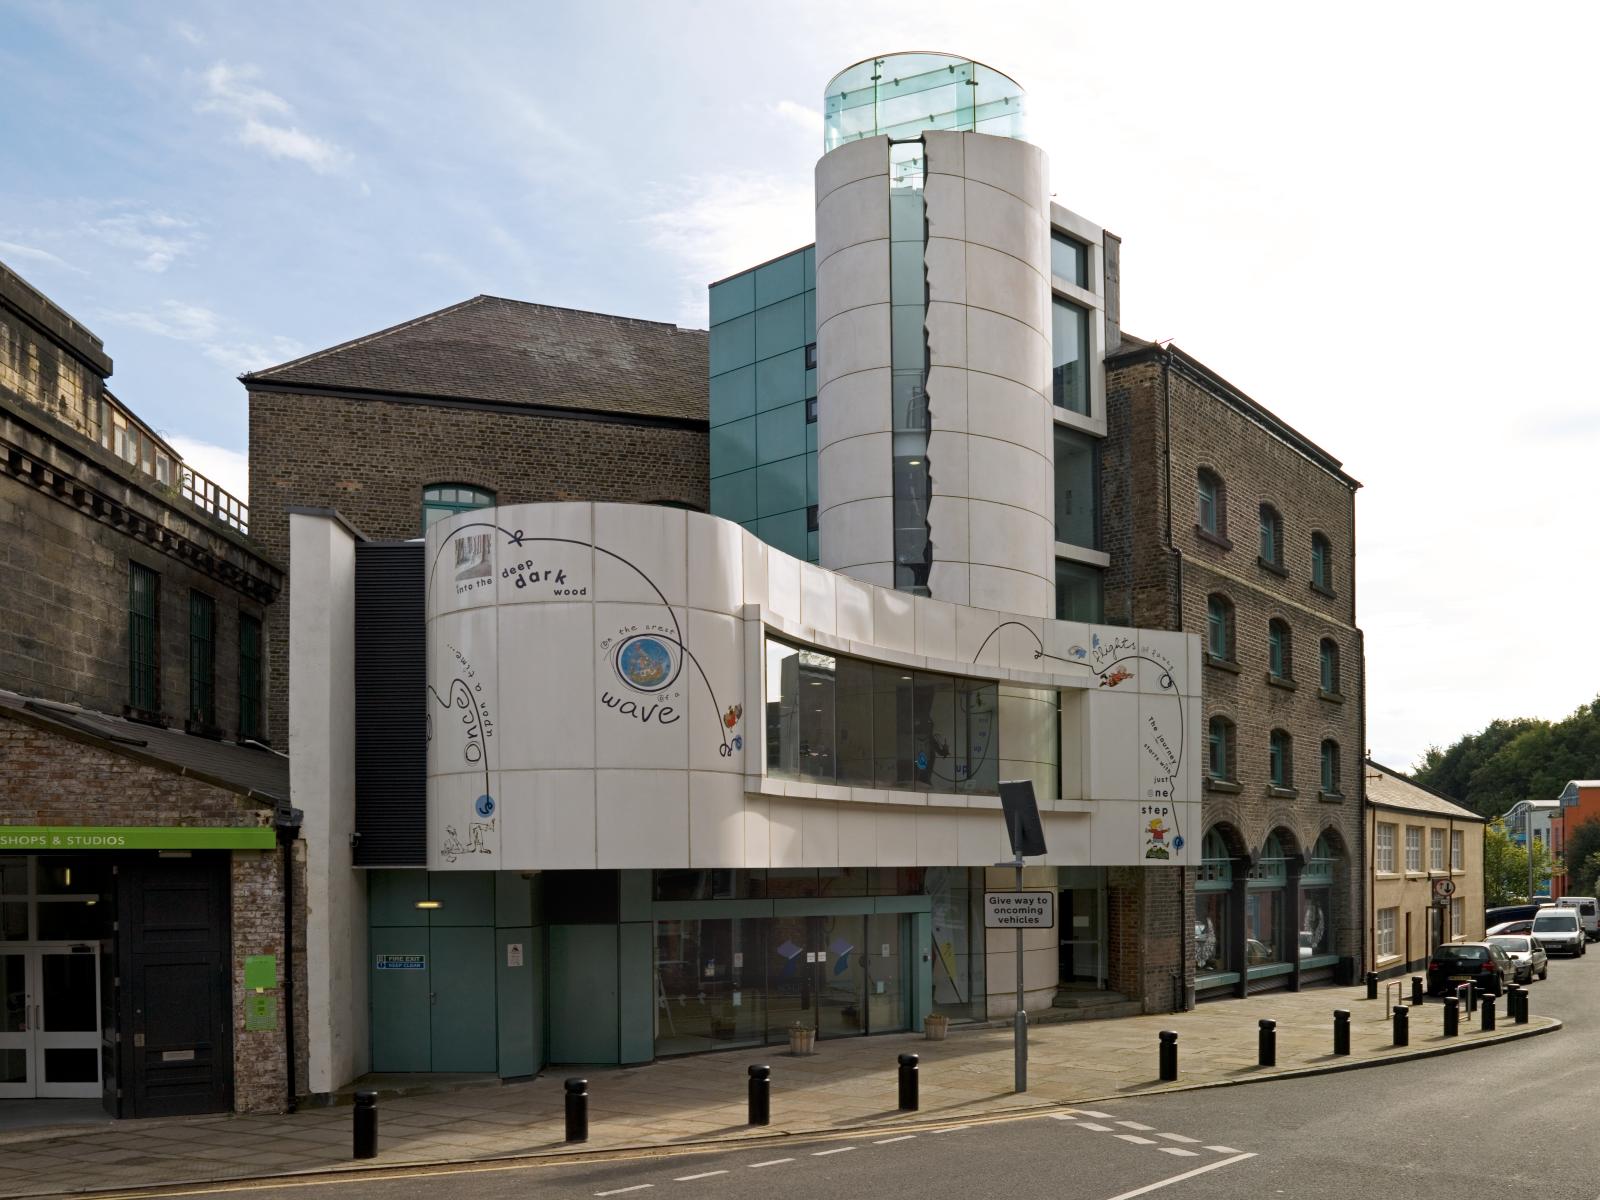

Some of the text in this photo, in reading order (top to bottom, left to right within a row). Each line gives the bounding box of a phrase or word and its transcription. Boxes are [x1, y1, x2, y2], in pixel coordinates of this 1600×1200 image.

[502, 560, 534, 578] deep
[515, 569, 567, 589] dark
[455, 578, 493, 595] into the
[553, 587, 587, 596] wood
[618, 625, 639, 635] the
[475, 683, 482, 692] a
[601, 691, 681, 724] wave
[480, 702, 493, 737] upon
[1155, 734, 1177, 765] journey
[1143, 743, 1171, 774] starts with
[955, 765, 968, 777] up
[1153, 776, 1169, 784] just
[1141, 805, 1168, 817] step
[52, 836, 61, 845] &
[66, 836, 126, 845] STUDIOS
[994, 906, 1044, 915] oncoming
[998, 916, 1040, 924] vehicles
